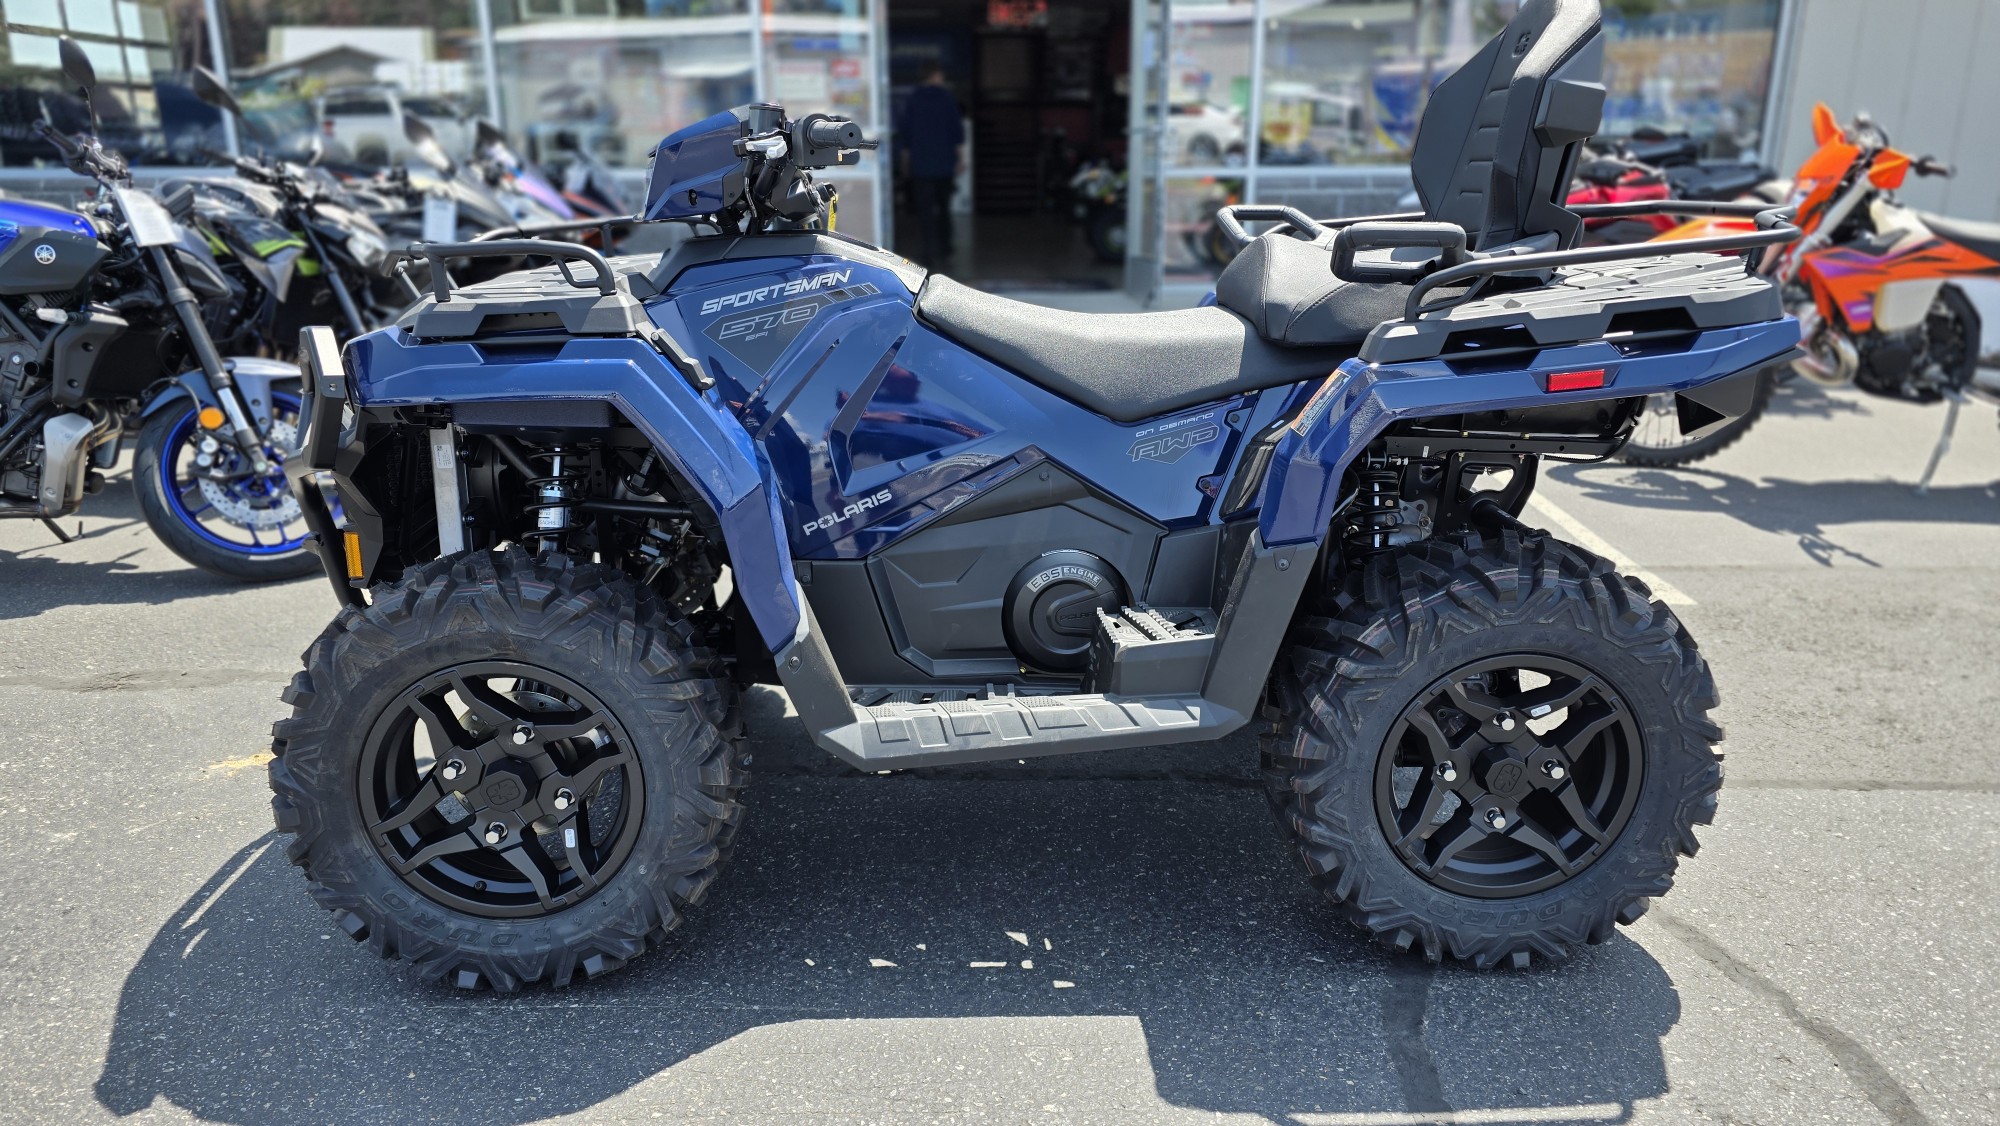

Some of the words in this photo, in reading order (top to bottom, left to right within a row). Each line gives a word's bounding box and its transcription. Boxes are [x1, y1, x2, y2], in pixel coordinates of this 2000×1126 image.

[700, 269, 851, 316] SPORTSMAN
[719, 303, 819, 340] 570
[745, 331, 769, 342] EFI
[1132, 425, 1220, 462] AWD
[1135, 428, 1154, 438] ON
[1159, 412, 1214, 431] DEMAND
[802, 489, 893, 536] POLARIS
[1030, 567, 1061, 590] EBS
[1063, 566, 1100, 583] ENGINE
[381, 893, 520, 948] DURO
[1427, 899, 1564, 928] DURO
